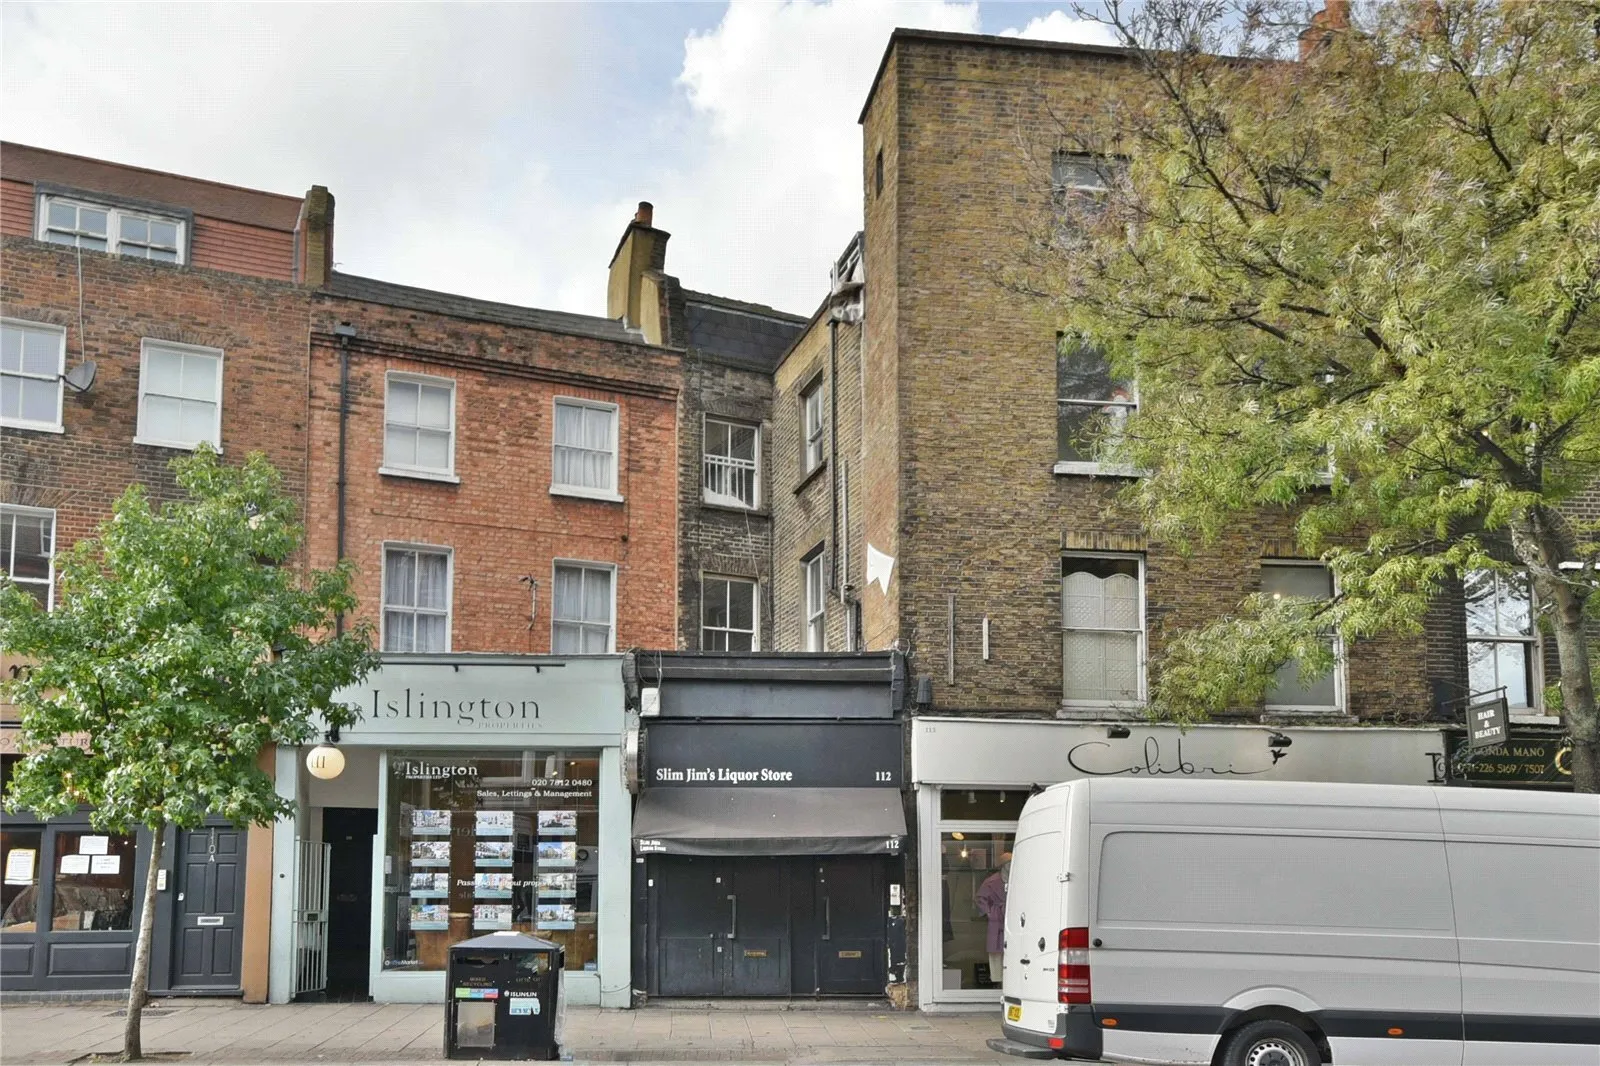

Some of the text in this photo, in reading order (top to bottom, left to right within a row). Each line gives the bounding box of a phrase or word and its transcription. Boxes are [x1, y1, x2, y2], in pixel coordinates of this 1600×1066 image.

[372, 688, 540, 726] Islington
[1477, 710, 1495, 720] HAIR
[478, 721, 543, 729] PROPERTIES
[1475, 726, 1501, 739] BEAUTY
[1068, 736, 1274, 775] Colibri
[1513, 747, 1545, 757] MANO
[406, 761, 478, 779] Islington
[656, 768, 793, 784] Slim Jim's Liquor Store
[875, 771, 892, 781] 112
[531, 779, 547, 787] 020
[571, 779, 592, 787] 0480
[476, 789, 500, 798] Sales,
[501, 789, 532, 799] Lettings
[543, 790, 593, 799] Management
[885, 840, 900, 849] 112
